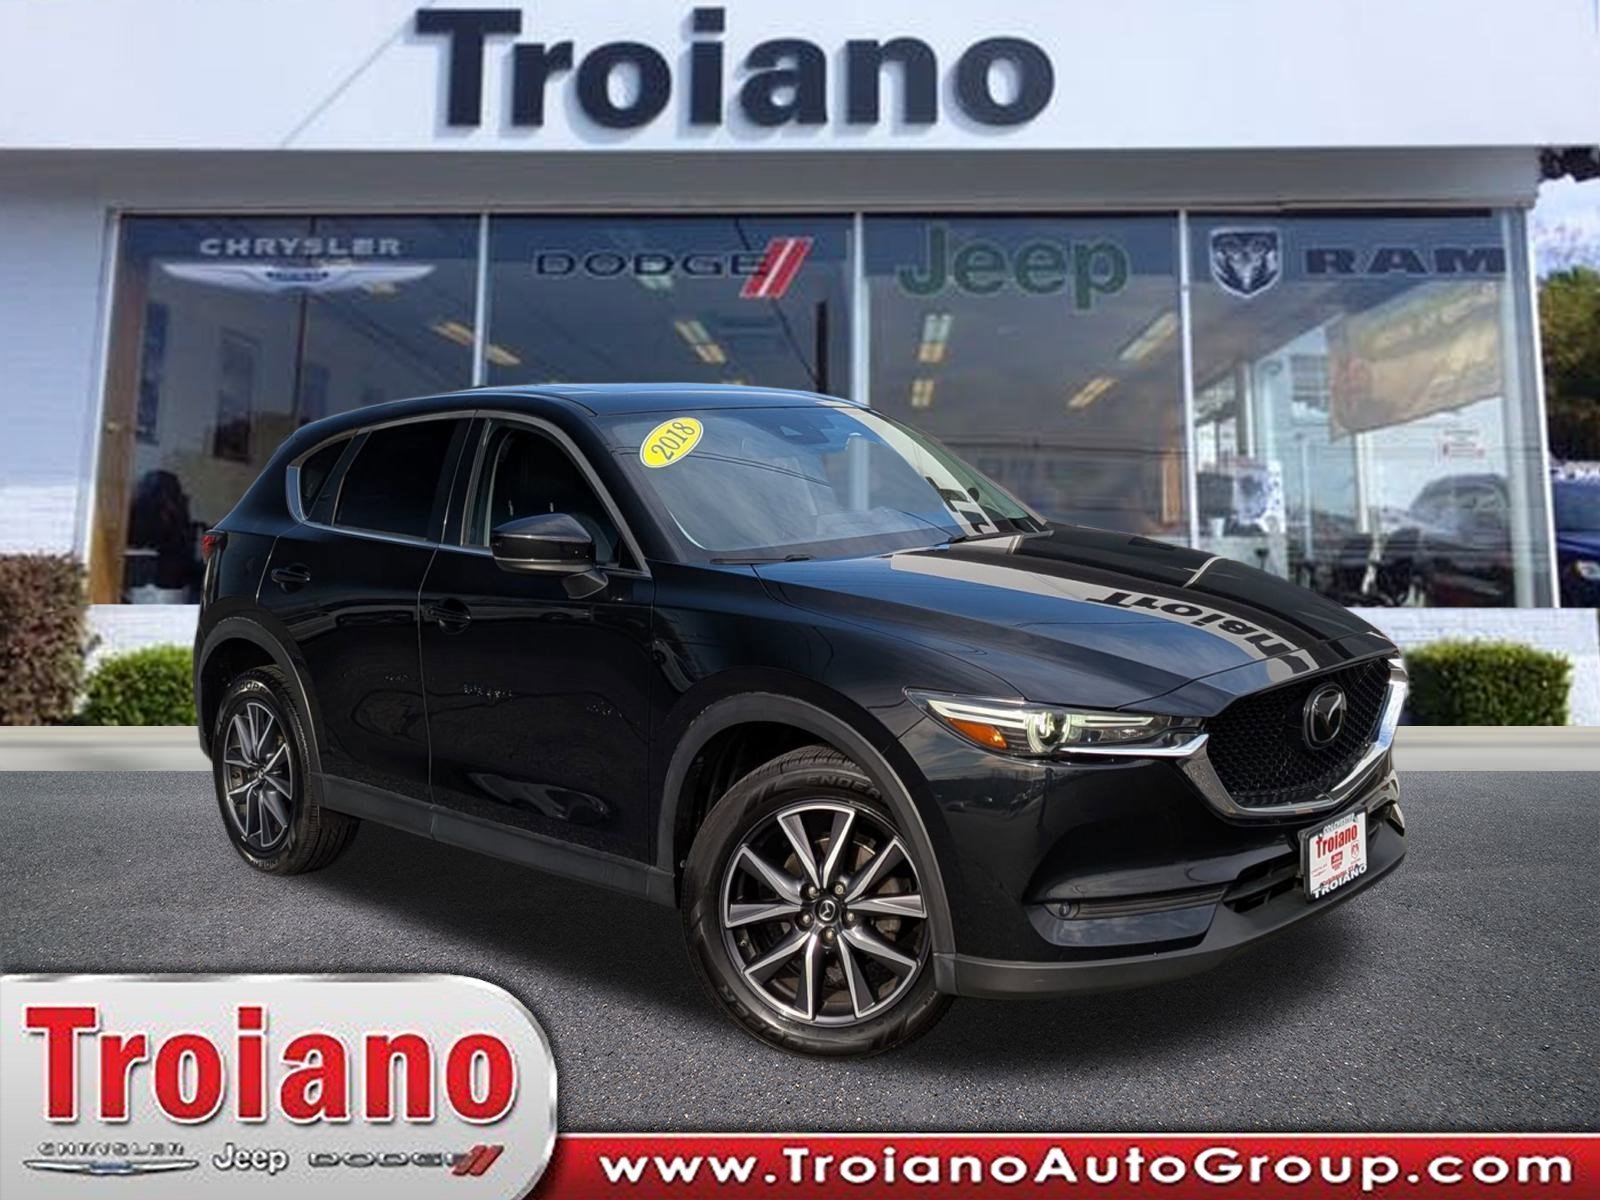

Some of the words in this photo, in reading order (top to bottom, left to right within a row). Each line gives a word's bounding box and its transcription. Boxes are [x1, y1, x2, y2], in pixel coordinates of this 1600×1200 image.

[415, 7, 1055, 129] Troiano
[200, 237, 401, 256] CHRYSLER
[1305, 247, 1506, 274] RAM
[535, 252, 767, 277] DODGE
[897, 222, 1129, 311] Jeep
[650, 421, 696, 461] 2018
[1315, 824, 1358, 859] Troiano
[1312, 863, 1368, 899] TROIANO
